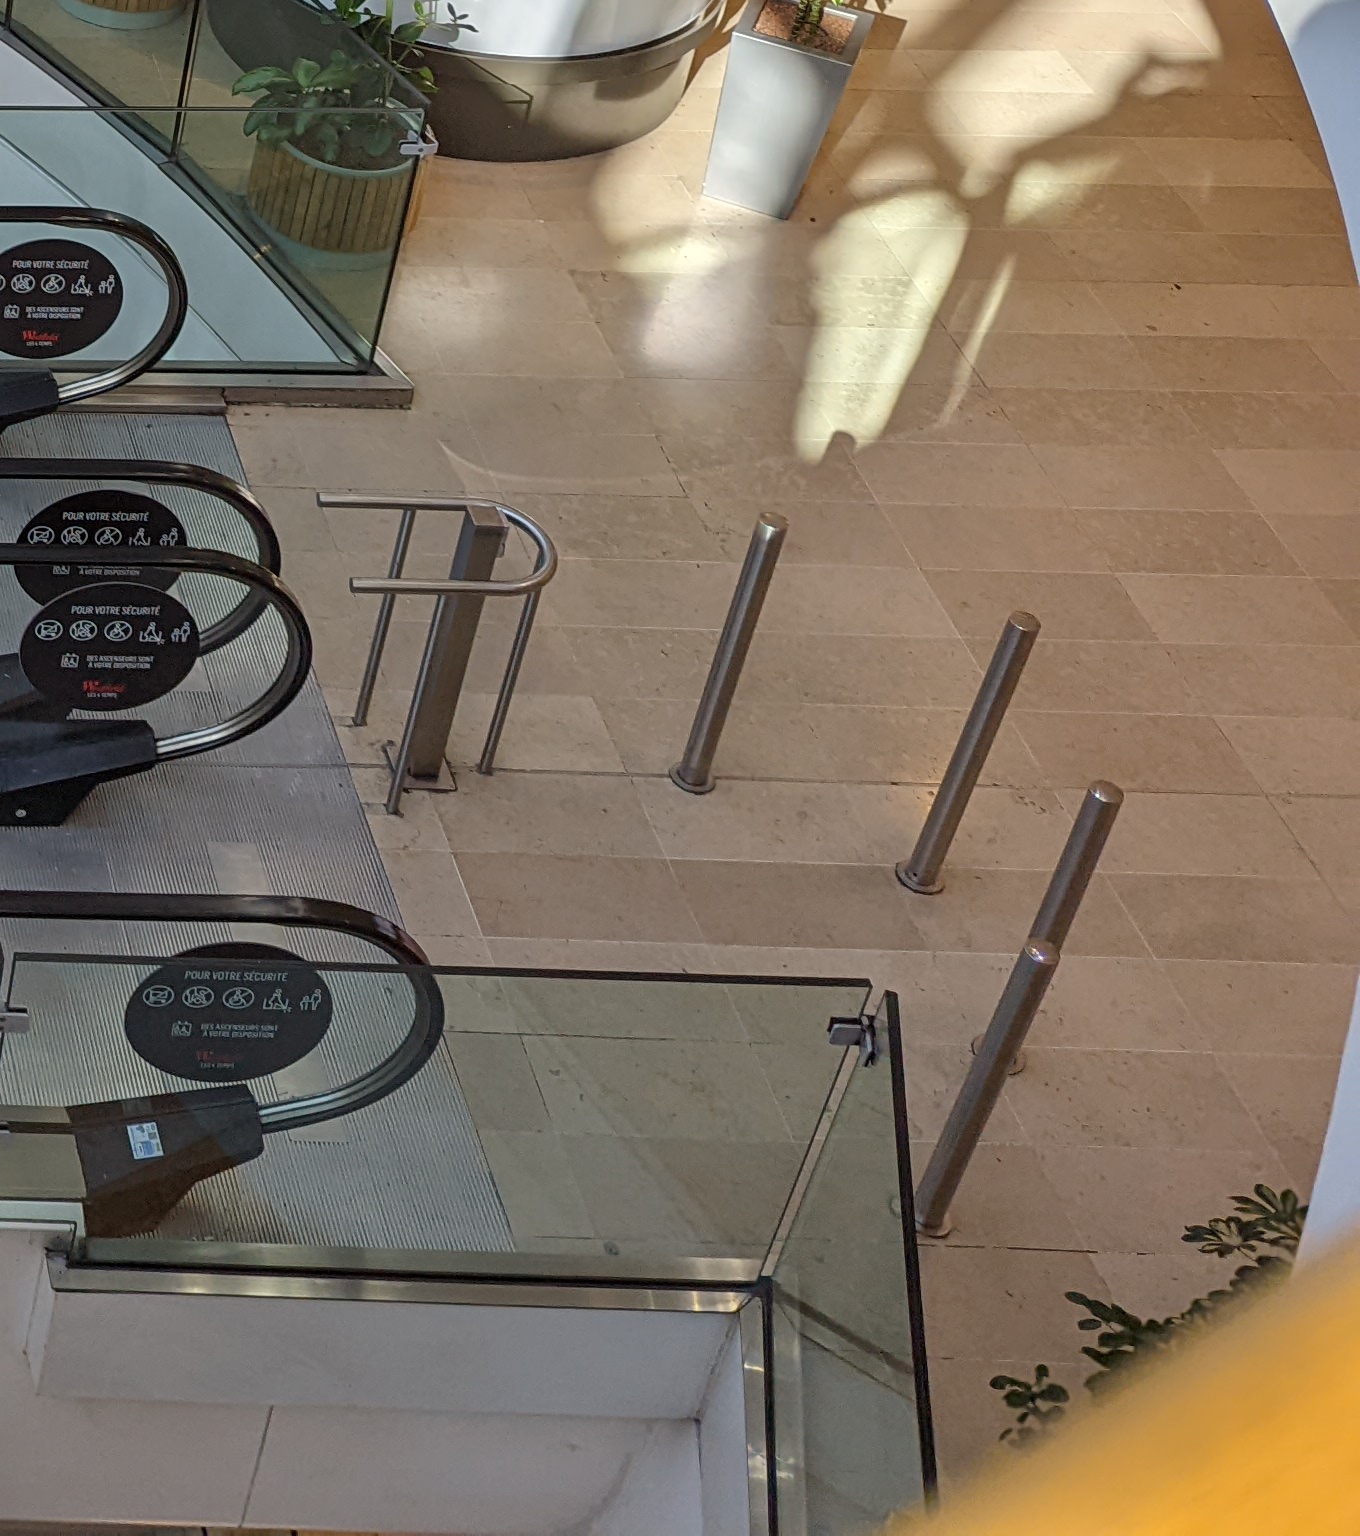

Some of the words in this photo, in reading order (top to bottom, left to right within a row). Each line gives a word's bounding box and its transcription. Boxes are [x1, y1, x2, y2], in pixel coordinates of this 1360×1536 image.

[12, 260, 31, 269] POUR
[33, 260, 55, 269] VOTRE
[62, 511, 84, 520] POUR
[85, 512, 110, 521] VOTRE
[111, 511, 149, 522] SÉCURITÉ
[71, 605, 93, 615] POUR
[95, 606, 120, 616] VOTRE
[121, 605, 161, 616] SÉCURITÉ
[184, 970, 211, 980] POUR
[212, 971, 241, 981] VOTRE
